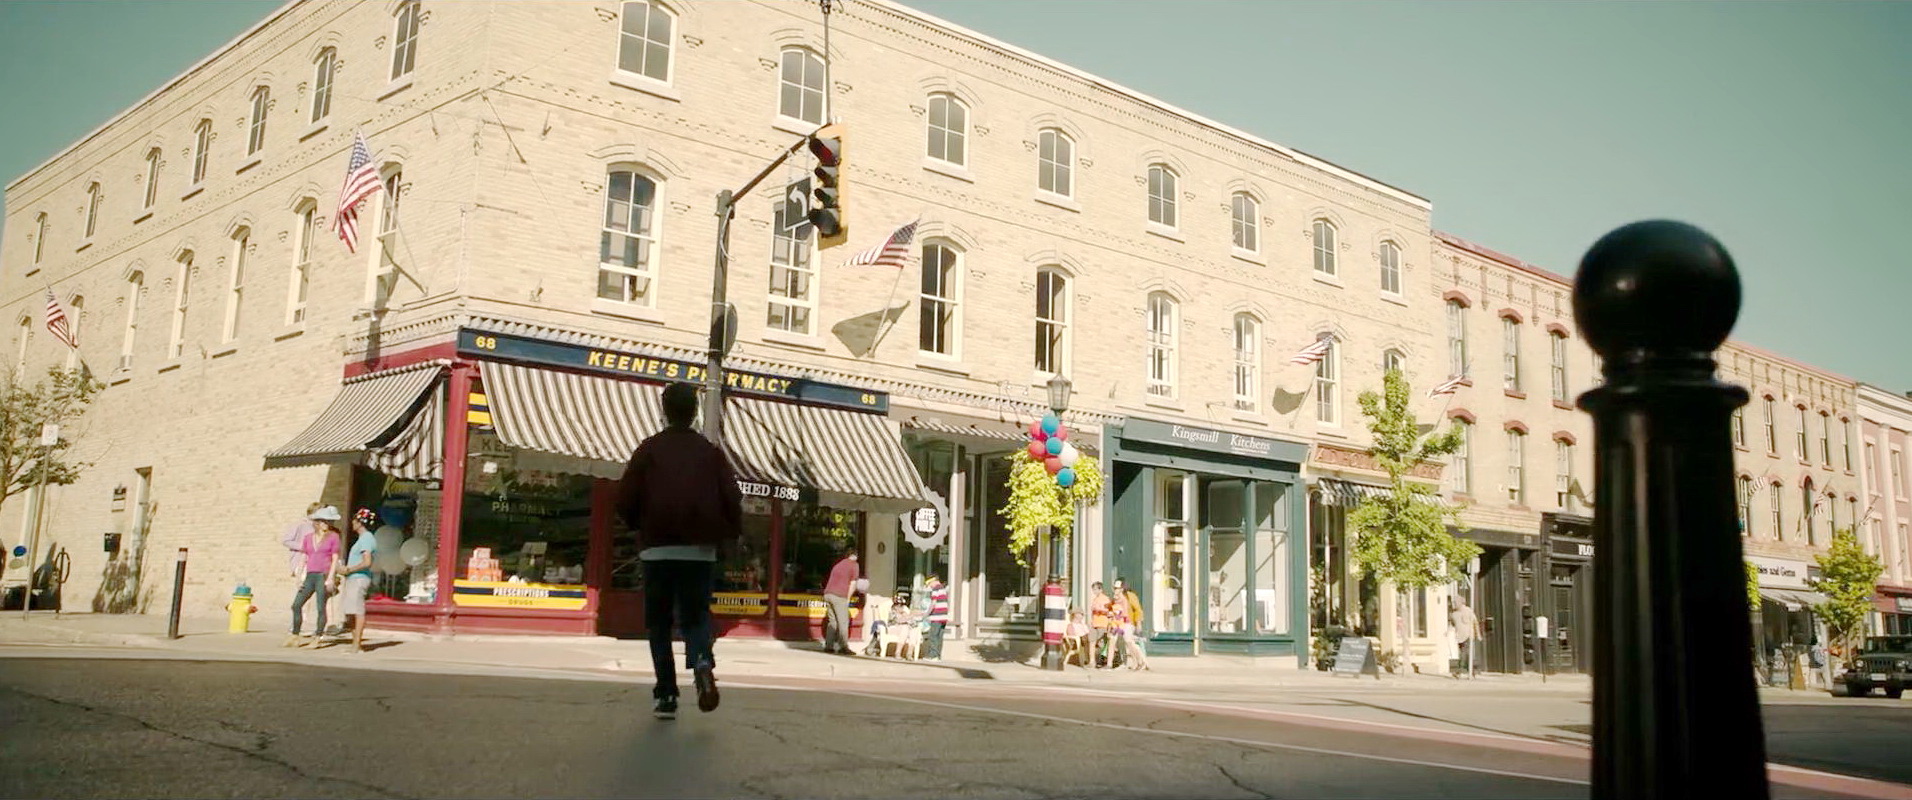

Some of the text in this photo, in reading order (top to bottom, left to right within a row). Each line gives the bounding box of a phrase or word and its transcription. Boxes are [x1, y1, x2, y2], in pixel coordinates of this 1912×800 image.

[475, 335, 497, 350] 68
[588, 351, 791, 394] KEENE'S PRMACY
[861, 394, 876, 405] 68
[1171, 425, 1220, 444] Kingsmill
[1230, 434, 1271, 451] Kitchens
[773, 485, 800, 501] 1888
[492, 587, 550, 598] PRESCRIPTIONS
